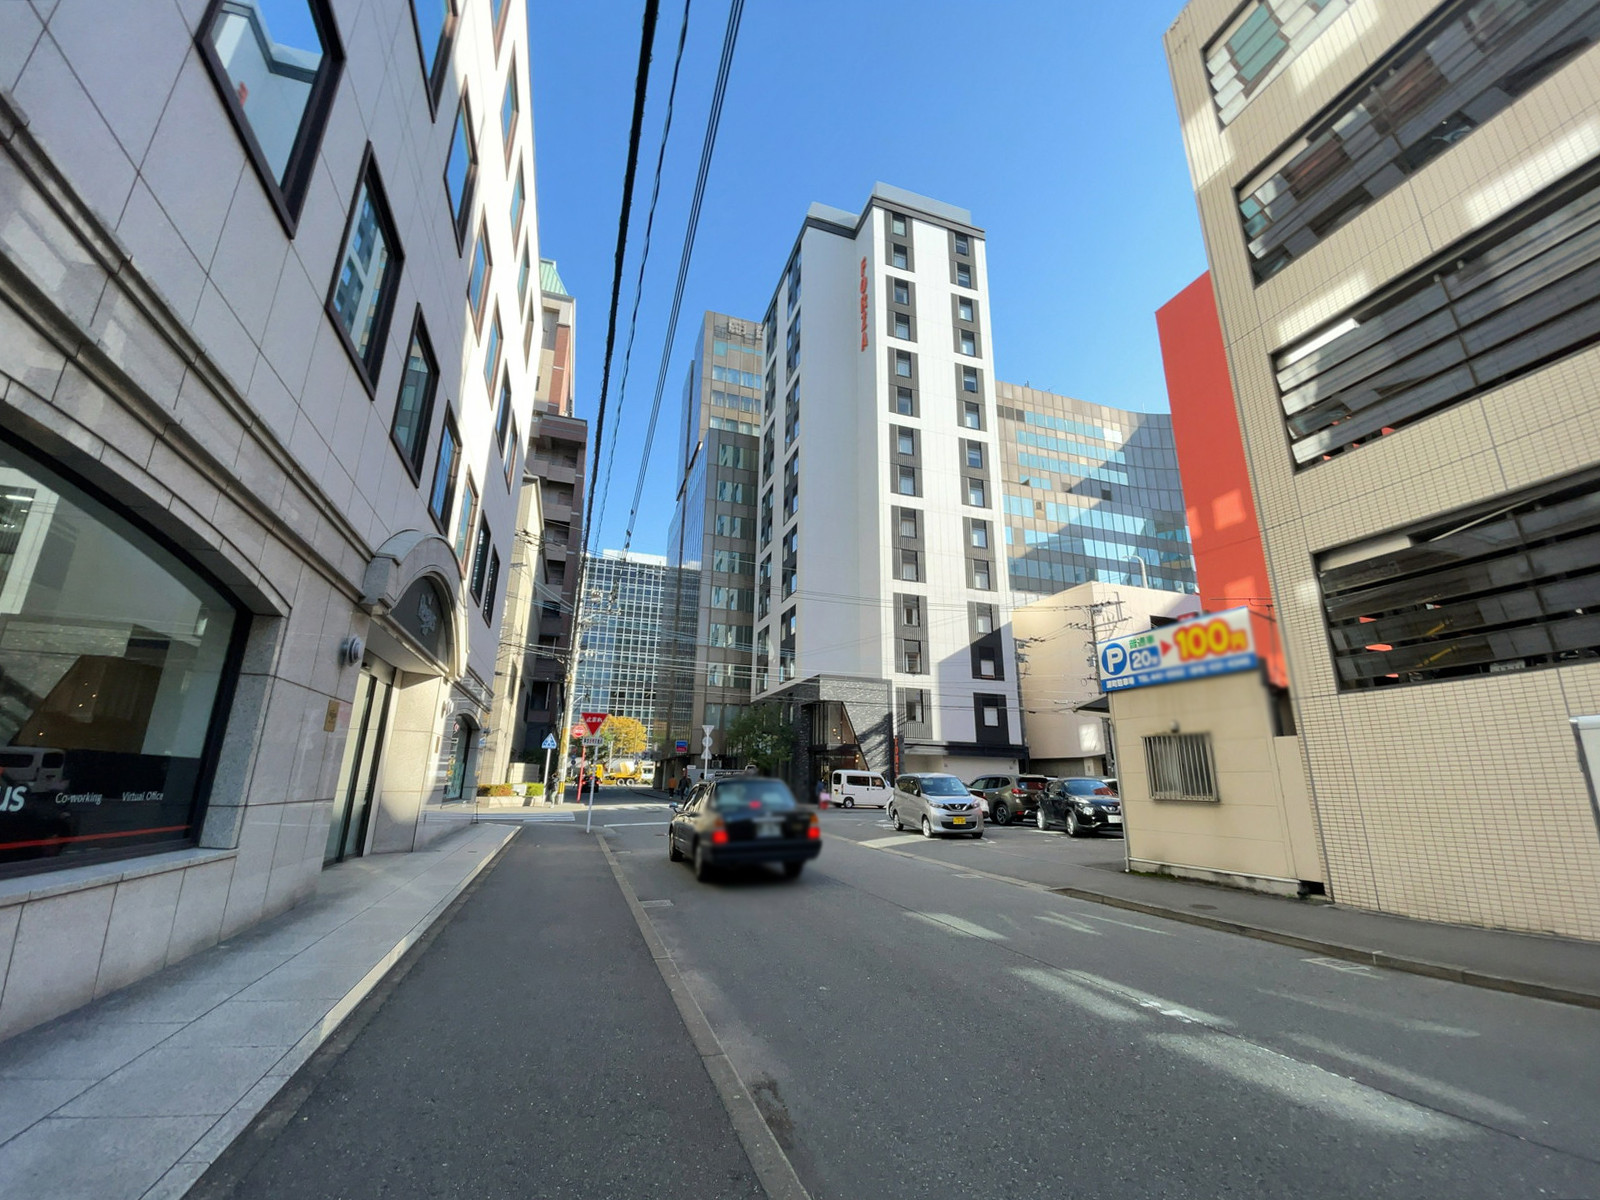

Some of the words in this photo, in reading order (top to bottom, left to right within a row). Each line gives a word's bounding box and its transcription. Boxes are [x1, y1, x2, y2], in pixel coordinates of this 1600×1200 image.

[1173, 619, 1248, 662] 100円
[1106, 647, 1124, 673] P
[55, 792, 103, 806] Co-working
[122, 791, 145, 802] Virtual
[145, 791, 164, 801] Office
